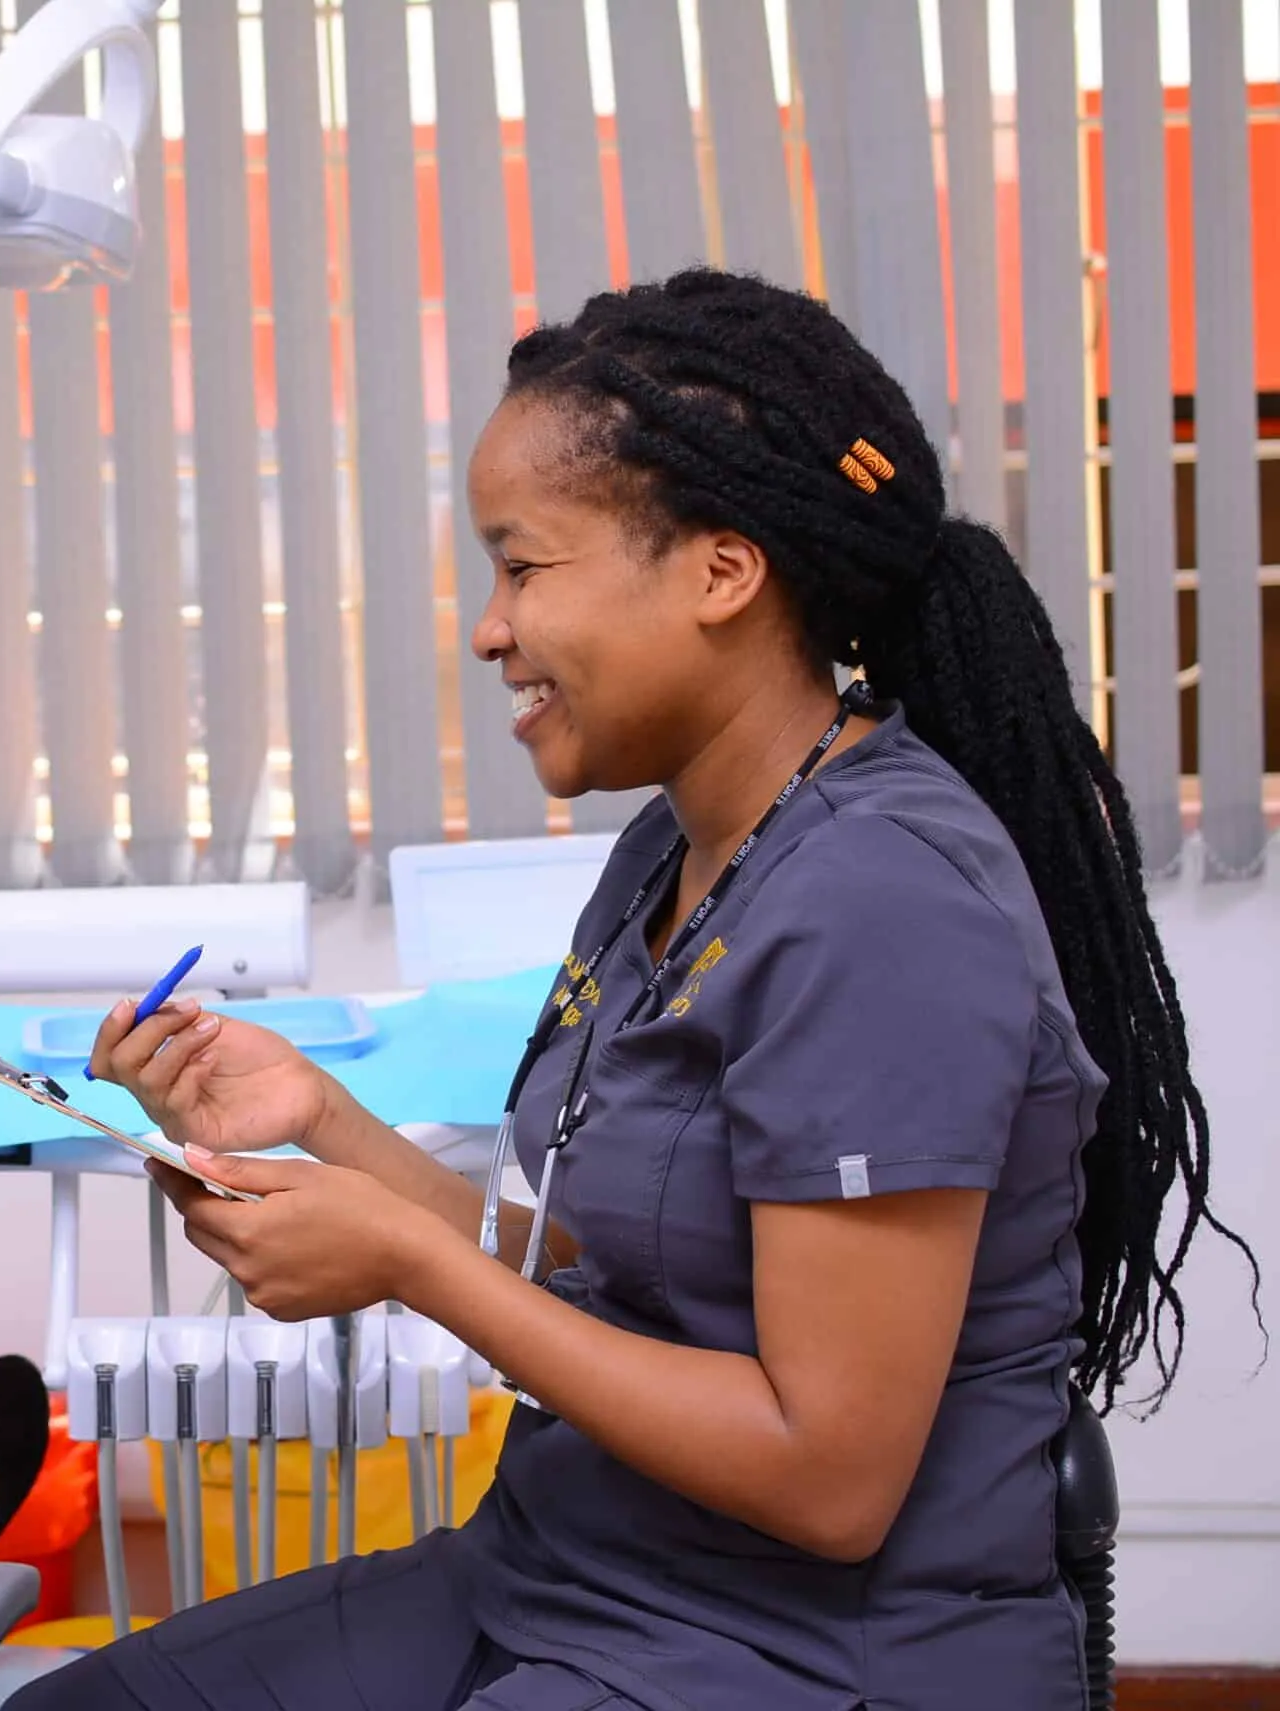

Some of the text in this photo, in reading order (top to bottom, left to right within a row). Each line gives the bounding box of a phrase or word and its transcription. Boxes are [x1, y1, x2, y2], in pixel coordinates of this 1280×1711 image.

[818, 723, 840, 750] SPORTS
[775, 774, 802, 805] SPORTS
[730, 834, 757, 868] SPORTS
[623, 888, 646, 921] SPORTS
[688, 896, 715, 931] SPORTS
